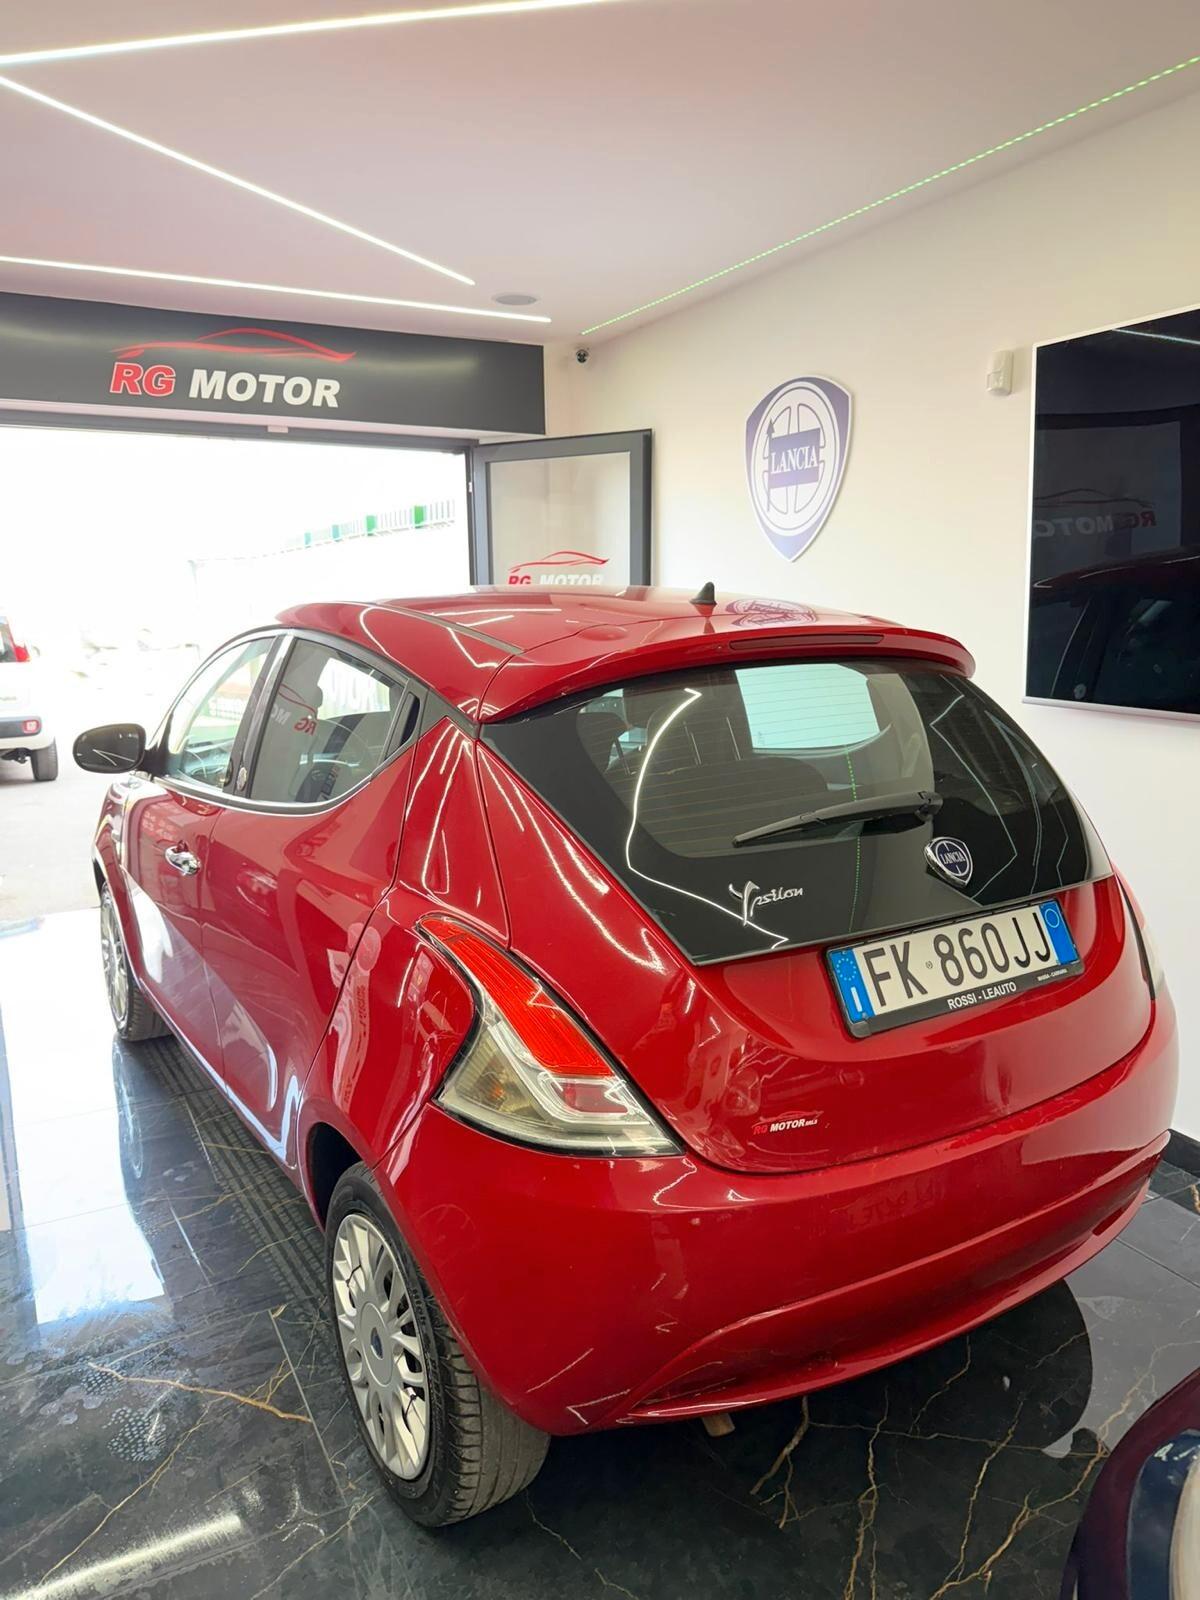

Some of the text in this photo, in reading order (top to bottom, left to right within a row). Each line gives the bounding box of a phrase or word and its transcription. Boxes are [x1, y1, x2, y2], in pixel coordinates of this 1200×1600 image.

[109, 361, 341, 408] RG MOTOR
[770, 445, 819, 475] LANCIA
[728, 880, 803, 927] Ypsilon
[863, 940, 928, 1007] FK
[933, 912, 1051, 986] 860JJ
[946, 992, 978, 1010] ROSSI
[981, 981, 1017, 1000] LEAUTO
[769, 1118, 806, 1133] MOTOR
